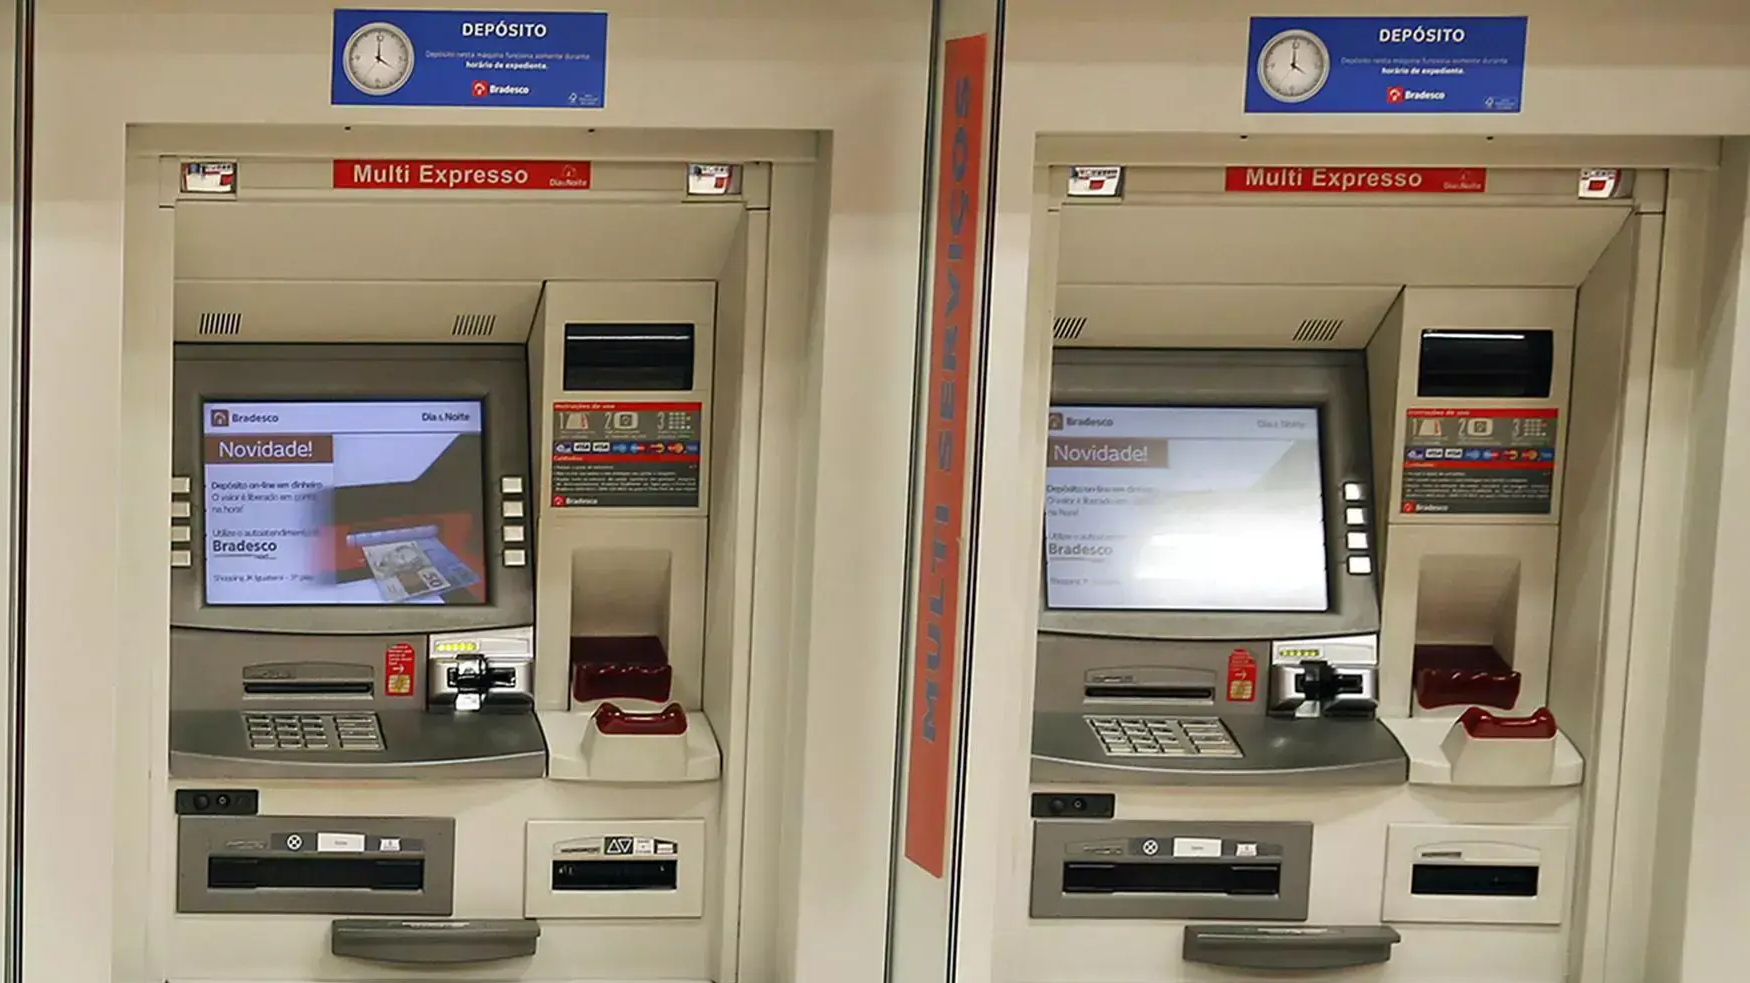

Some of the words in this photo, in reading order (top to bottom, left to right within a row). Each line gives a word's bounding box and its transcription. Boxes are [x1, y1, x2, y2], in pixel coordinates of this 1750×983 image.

[462, 20, 547, 37] DEPÓSITO
[1379, 26, 1465, 43] DEPÓSITO
[489, 85, 529, 94] Bradesco
[1405, 90, 1445, 100] Bradesco
[353, 164, 410, 183] Multi
[419, 164, 529, 187] Expresso
[1246, 168, 1303, 186] Multi
[1312, 168, 1423, 190] Expresso
[422, 411, 437, 422] Dia
[445, 412, 471, 422] Noite
[922, 503, 950, 743] MULTI
[938, 76, 971, 475] SERVIÇOS
[232, 412, 279, 423] Bradesco
[658, 411, 666, 430] 3
[1066, 416, 1114, 427] Bradesco
[219, 440, 313, 459] Novidade!
[1053, 444, 1149, 463] Novidade!
[211, 480, 247, 491] Depósito
[213, 539, 278, 552] Bradesco
[1049, 542, 1114, 556] Bradesco
